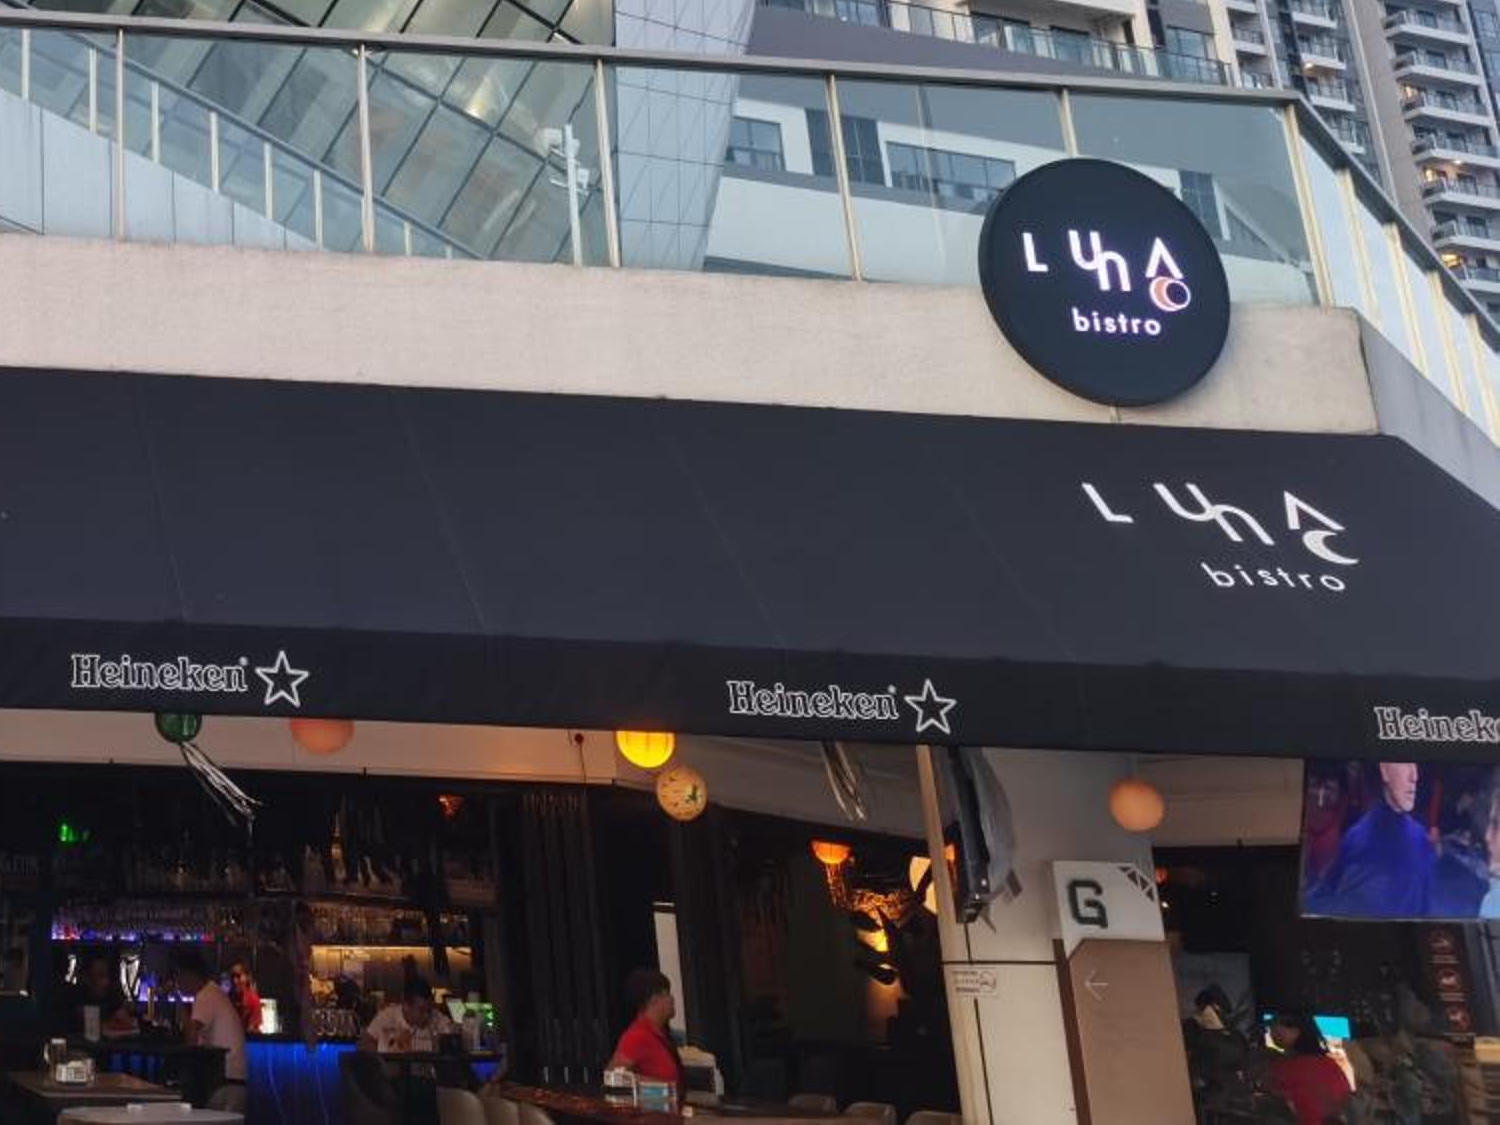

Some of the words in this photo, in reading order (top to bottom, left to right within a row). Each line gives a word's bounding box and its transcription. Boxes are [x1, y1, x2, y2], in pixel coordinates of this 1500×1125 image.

[1071, 306, 1163, 337] bistro
[1200, 561, 1347, 593] bistro
[1067, 879, 1109, 929] G
